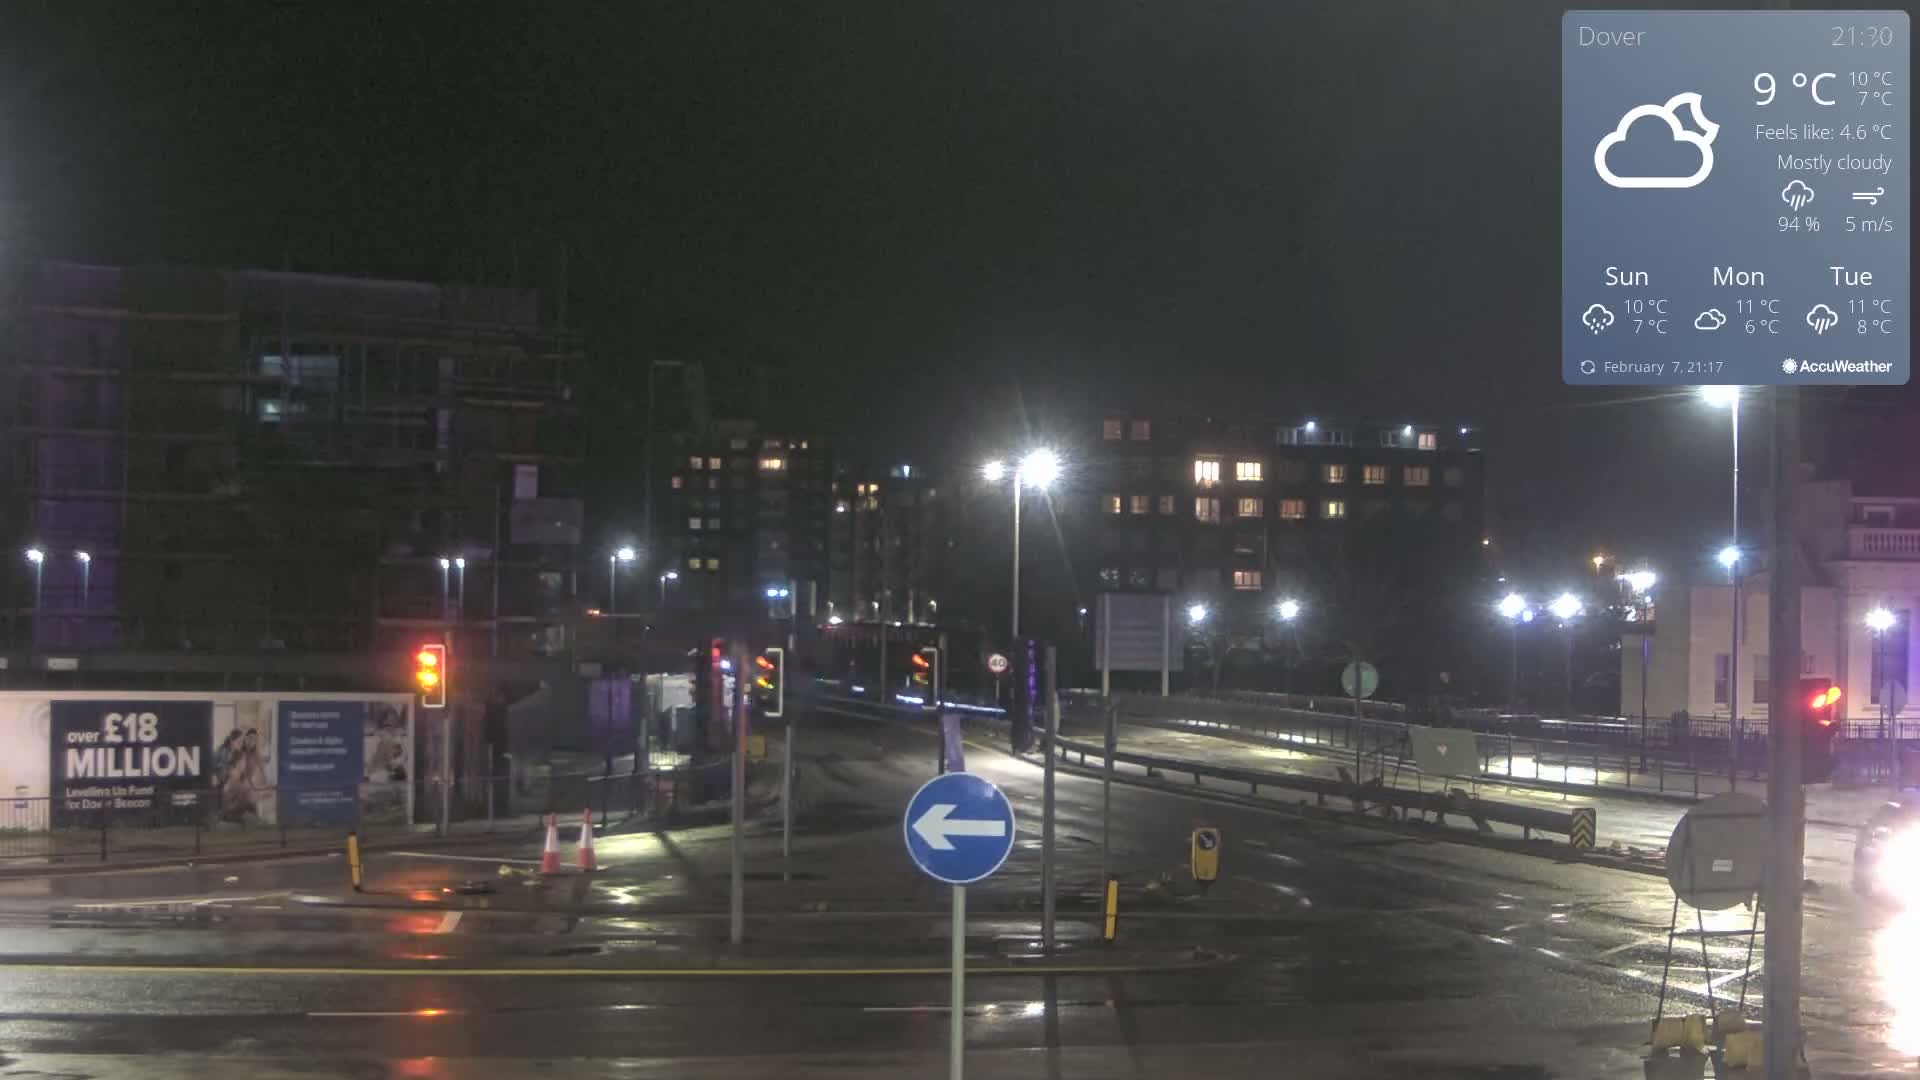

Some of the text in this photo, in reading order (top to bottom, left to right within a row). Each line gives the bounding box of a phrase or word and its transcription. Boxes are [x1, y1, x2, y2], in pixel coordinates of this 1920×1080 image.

[991, 658, 1007, 668] 40
[67, 712, 159, 743] over £18
[66, 746, 201, 778] MILLION
